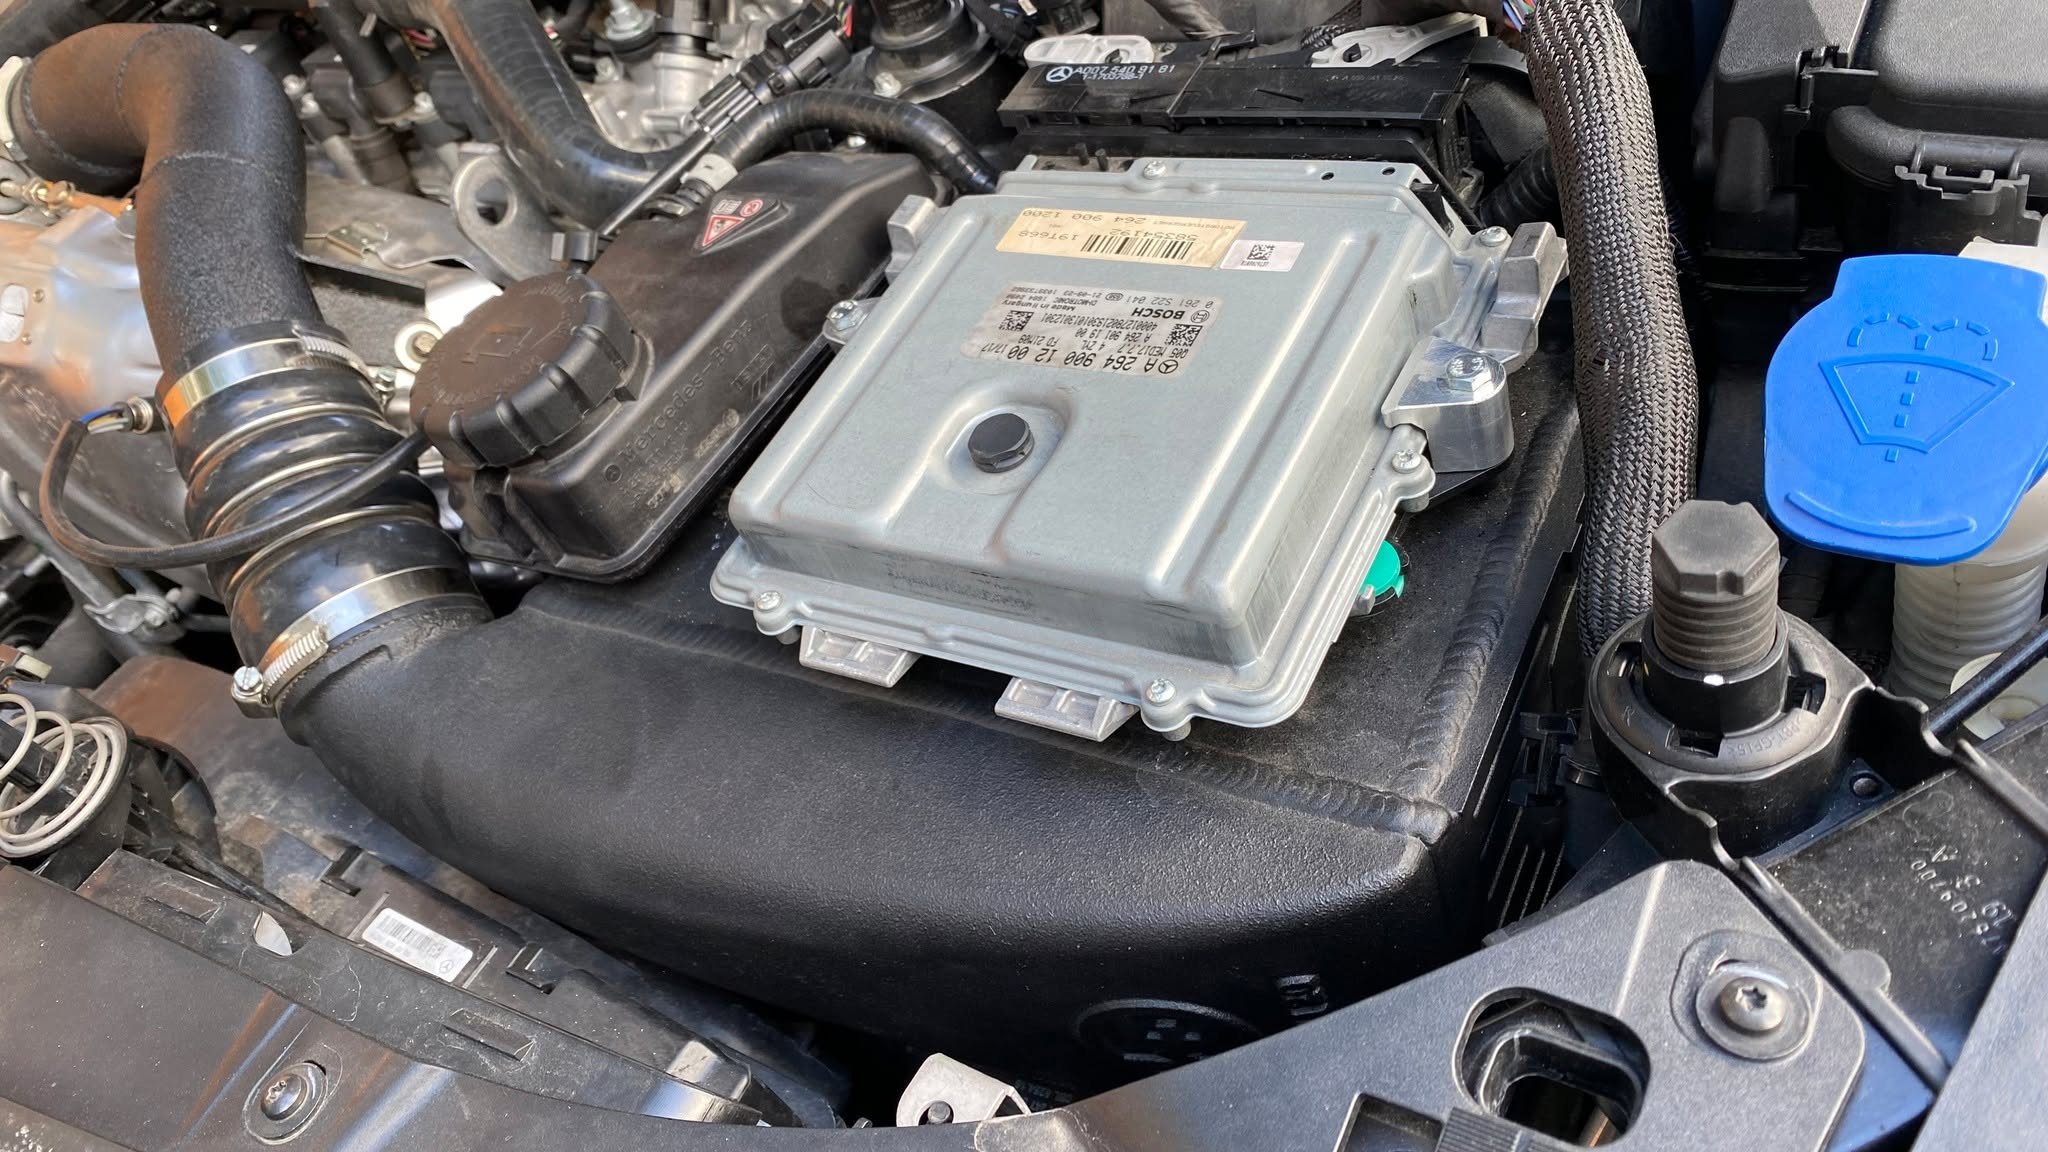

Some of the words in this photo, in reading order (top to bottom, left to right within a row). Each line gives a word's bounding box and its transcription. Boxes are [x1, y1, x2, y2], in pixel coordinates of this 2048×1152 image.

[1110, 66, 1135, 74] 540
[1022, 210, 1062, 219] 1200
[1072, 213, 1103, 222] 900
[1113, 216, 1146, 225] 264
[1018, 230, 1079, 241] 19T668
[1109, 228, 1198, 242] 58354192
[1126, 296, 1146, 304] 041
[1180, 298, 1200, 308] 261
[1131, 307, 1186, 320] BOSCH
[1124, 332, 1142, 342] 264
[1143, 332, 1152, 343] A
[1007, 345, 1030, 360] 00
[1034, 348, 1058, 364] 12
[1117, 344, 1168, 357] MED17.7.7
[1063, 351, 1096, 368] 900
[1102, 354, 1138, 371] 264
[1144, 358, 1158, 372] A
